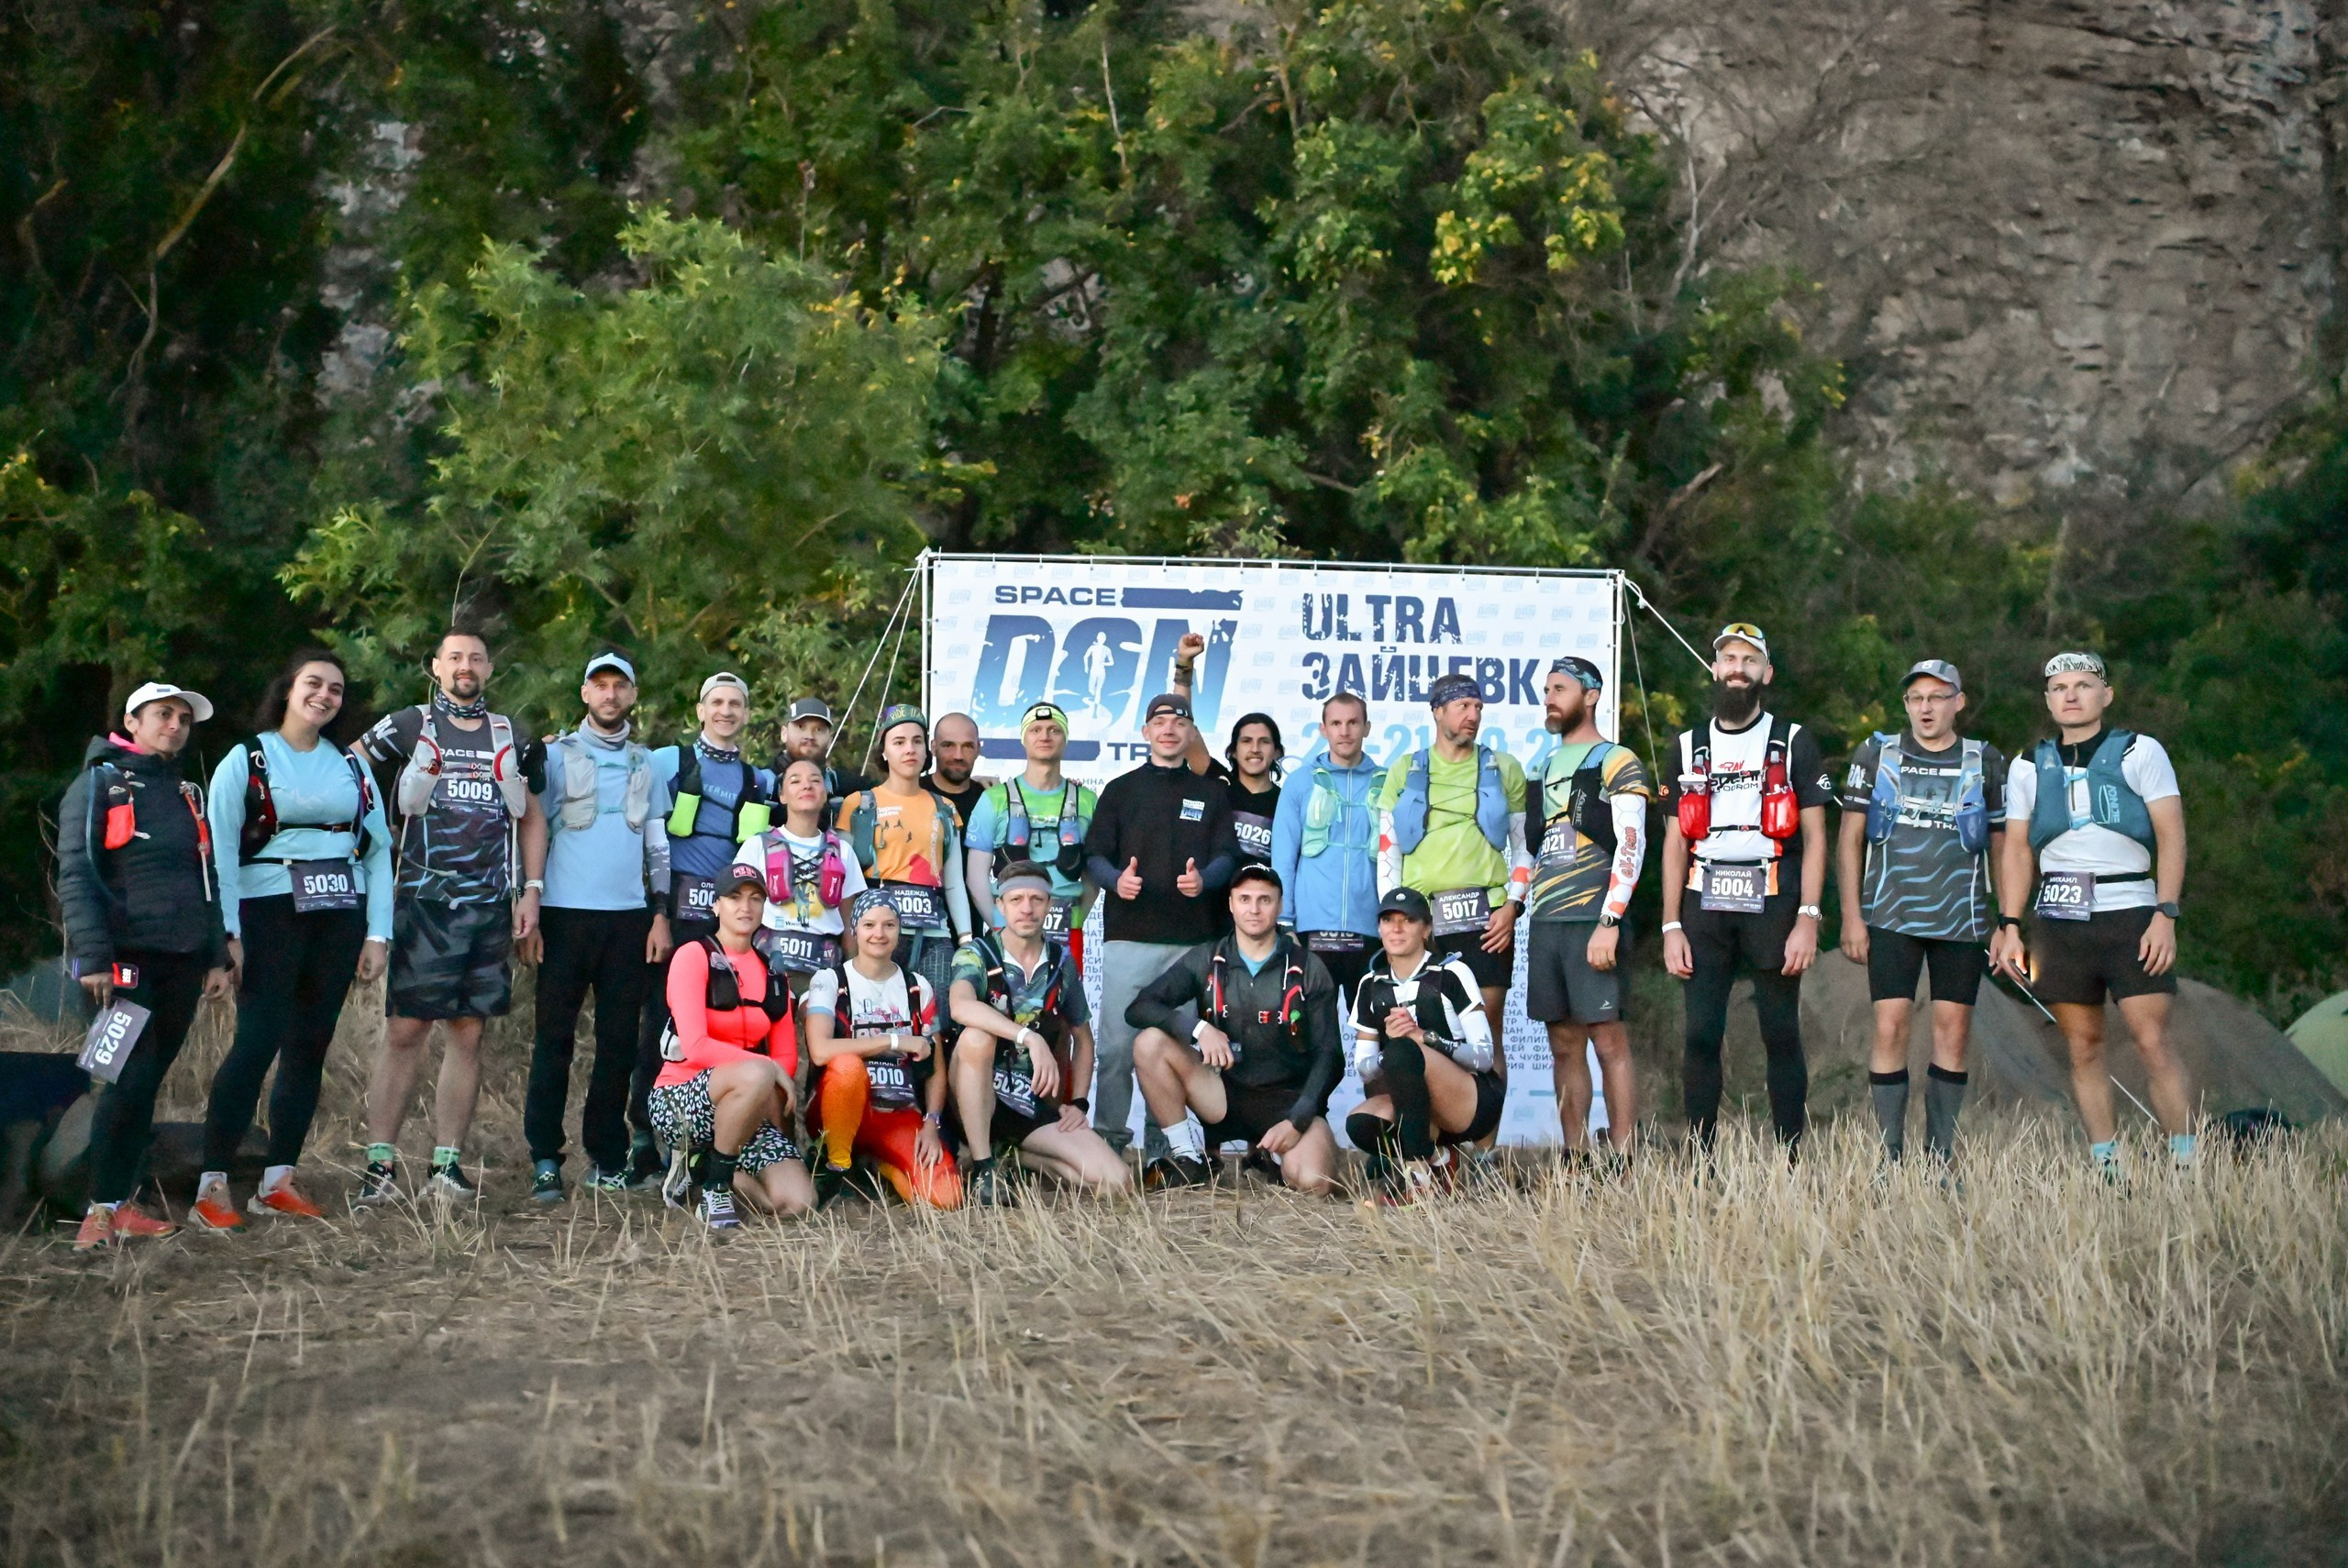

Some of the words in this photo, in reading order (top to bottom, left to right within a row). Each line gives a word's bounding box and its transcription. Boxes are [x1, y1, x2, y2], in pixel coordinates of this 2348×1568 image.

[995, 586, 1116, 607] SPACE
[1302, 593, 1462, 644] ULTRA
[1302, 646, 1559, 706] ЗАЙЦВК
[890, 706, 906, 721] RIDE
[440, 748, 476, 758] PACE
[1107, 743, 1152, 761] TR
[1899, 767, 1939, 777] PACE
[448, 779, 493, 801] 5009
[1234, 822, 1272, 845] 5026
[1715, 869, 1752, 878] НИКОЛАЙ
[304, 873, 349, 895] 5030
[894, 889, 929, 898] НАДЕЖДА
[1711, 878, 1754, 898] 5004
[2043, 884, 2082, 904] 5023
[689, 889, 716, 906] 500
[1439, 891, 1480, 903] АЛЕКСАНДР
[1442, 900, 1479, 920] 5017
[1043, 914, 1062, 930] 07
[780, 937, 813, 958] 5011
[94, 1011, 133, 1066] 5029
[867, 1066, 904, 1086] 5010
